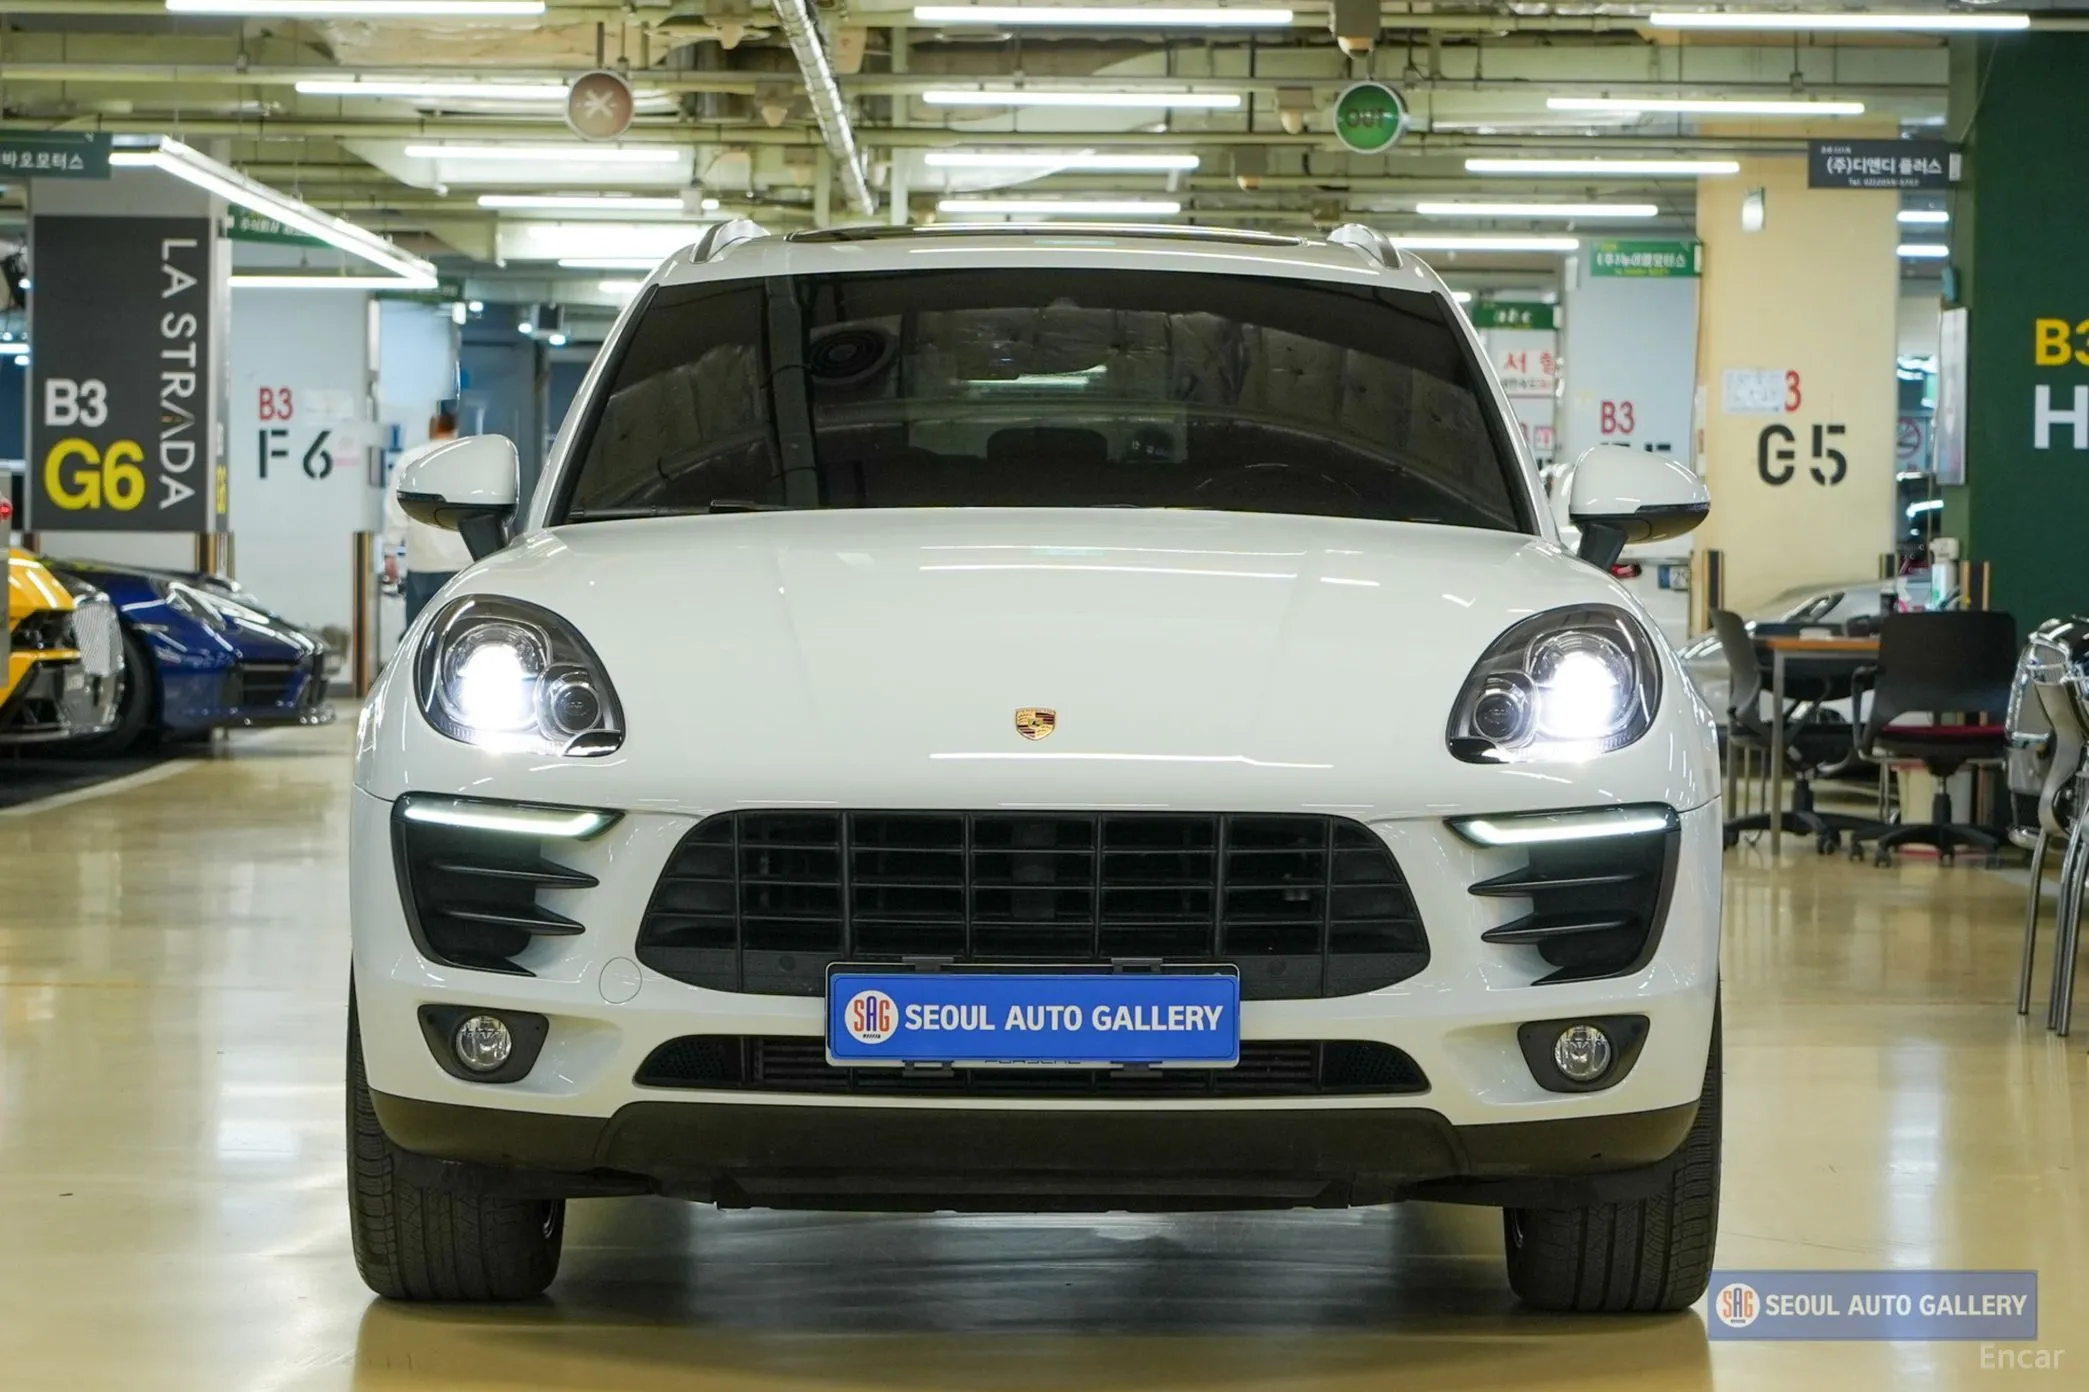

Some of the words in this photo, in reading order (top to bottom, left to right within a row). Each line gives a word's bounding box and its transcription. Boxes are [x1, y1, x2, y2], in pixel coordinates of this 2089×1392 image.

[1346, 107, 1386, 128] OUT
[161, 238, 198, 299] LA
[45, 377, 109, 428] B3
[259, 386, 294, 421] B3
[1601, 400, 1636, 435] B3
[44, 437, 146, 511] G6
[853, 995, 890, 1032] SAG
[904, 1004, 996, 1031] SEOUL
[1004, 1004, 1083, 1031] AUTO
[1091, 1004, 1224, 1031] GALLERY
